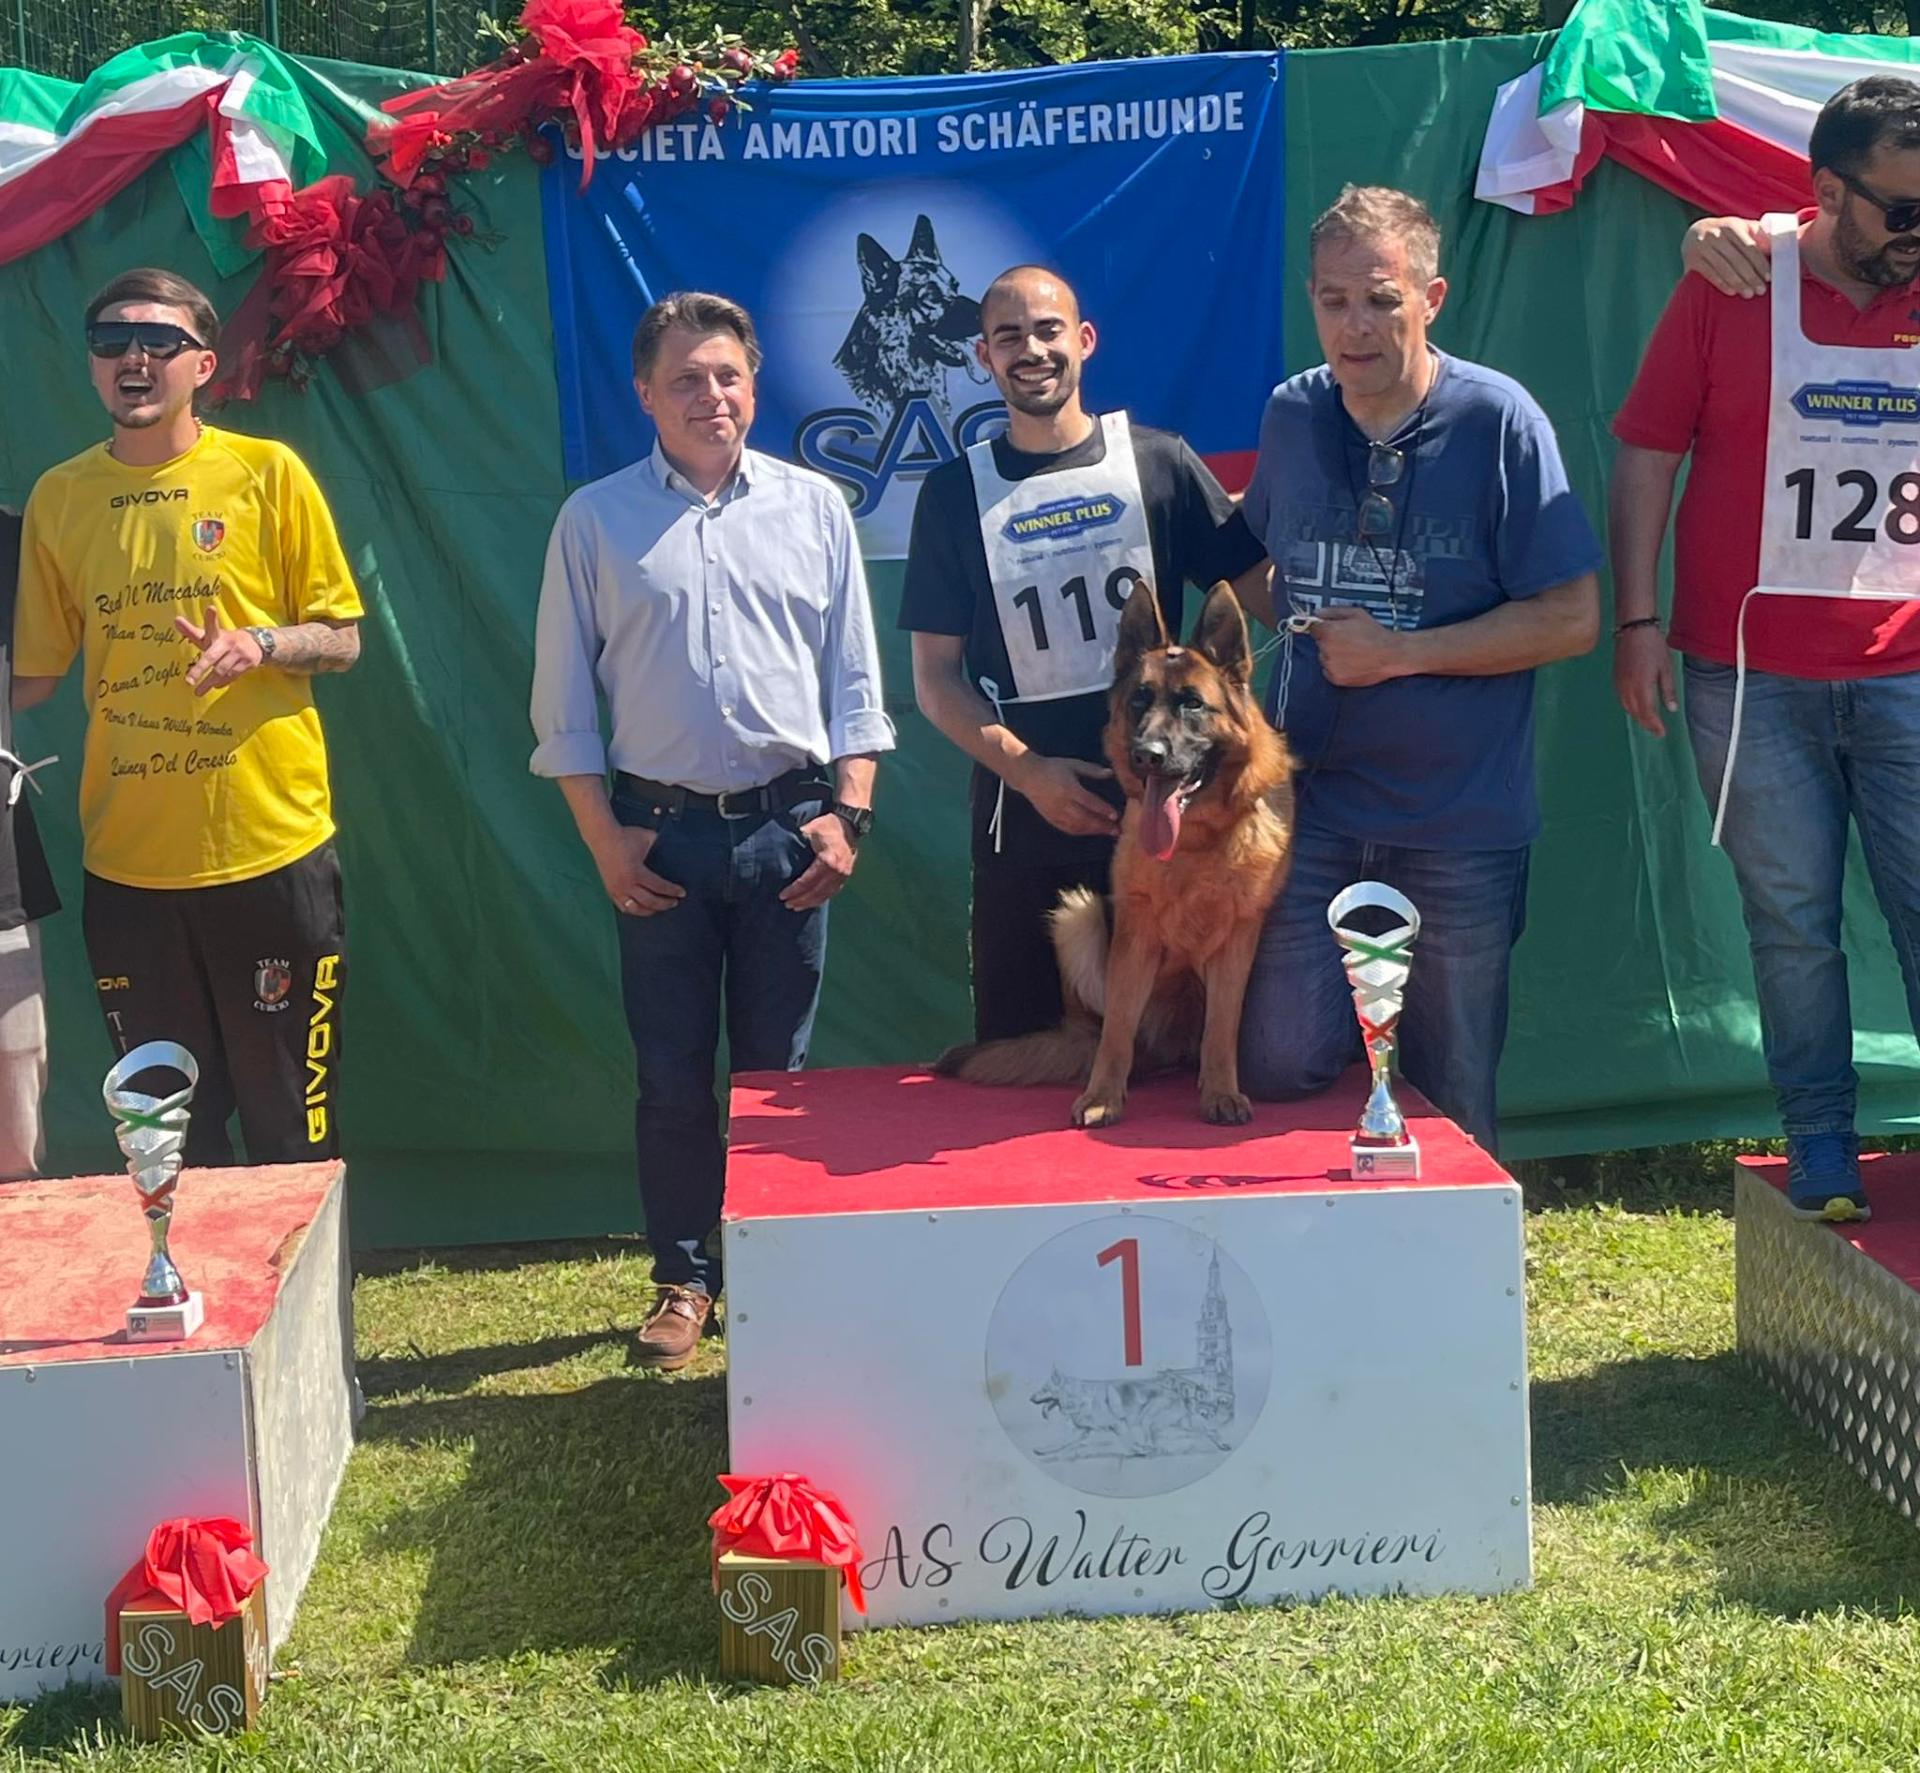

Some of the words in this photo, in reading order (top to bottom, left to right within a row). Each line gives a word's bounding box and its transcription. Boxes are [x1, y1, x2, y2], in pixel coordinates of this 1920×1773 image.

[743, 117, 917, 160] AMATORI
[937, 91, 1245, 154] SCHÄFERHUNDE
[1806, 394, 1873, 411] WINNER
[1877, 397, 1918, 413] PLUS
[110, 488, 188, 508] GIVOVA
[1012, 511, 1073, 534] WINNER
[1075, 502, 1112, 521] PLUS
[1784, 468, 1920, 545] 128
[95, 591, 122, 616] Red
[142, 575, 221, 604] Mercabah
[142, 660, 181, 688] Degli
[150, 752, 178, 774] Del
[96, 976, 130, 990] OVA
[256, 958, 290, 969] TEAM
[305, 954, 340, 1143] GIVOVA
[1095, 1238, 1142, 1366] 1
[841, 1522, 962, 1591] AS
[980, 1510, 1188, 1591] Walter
[1201, 1511, 1447, 1600] Gorrieri
[720, 1572, 836, 1690] SAS
[121, 1624, 245, 1736] SAS
